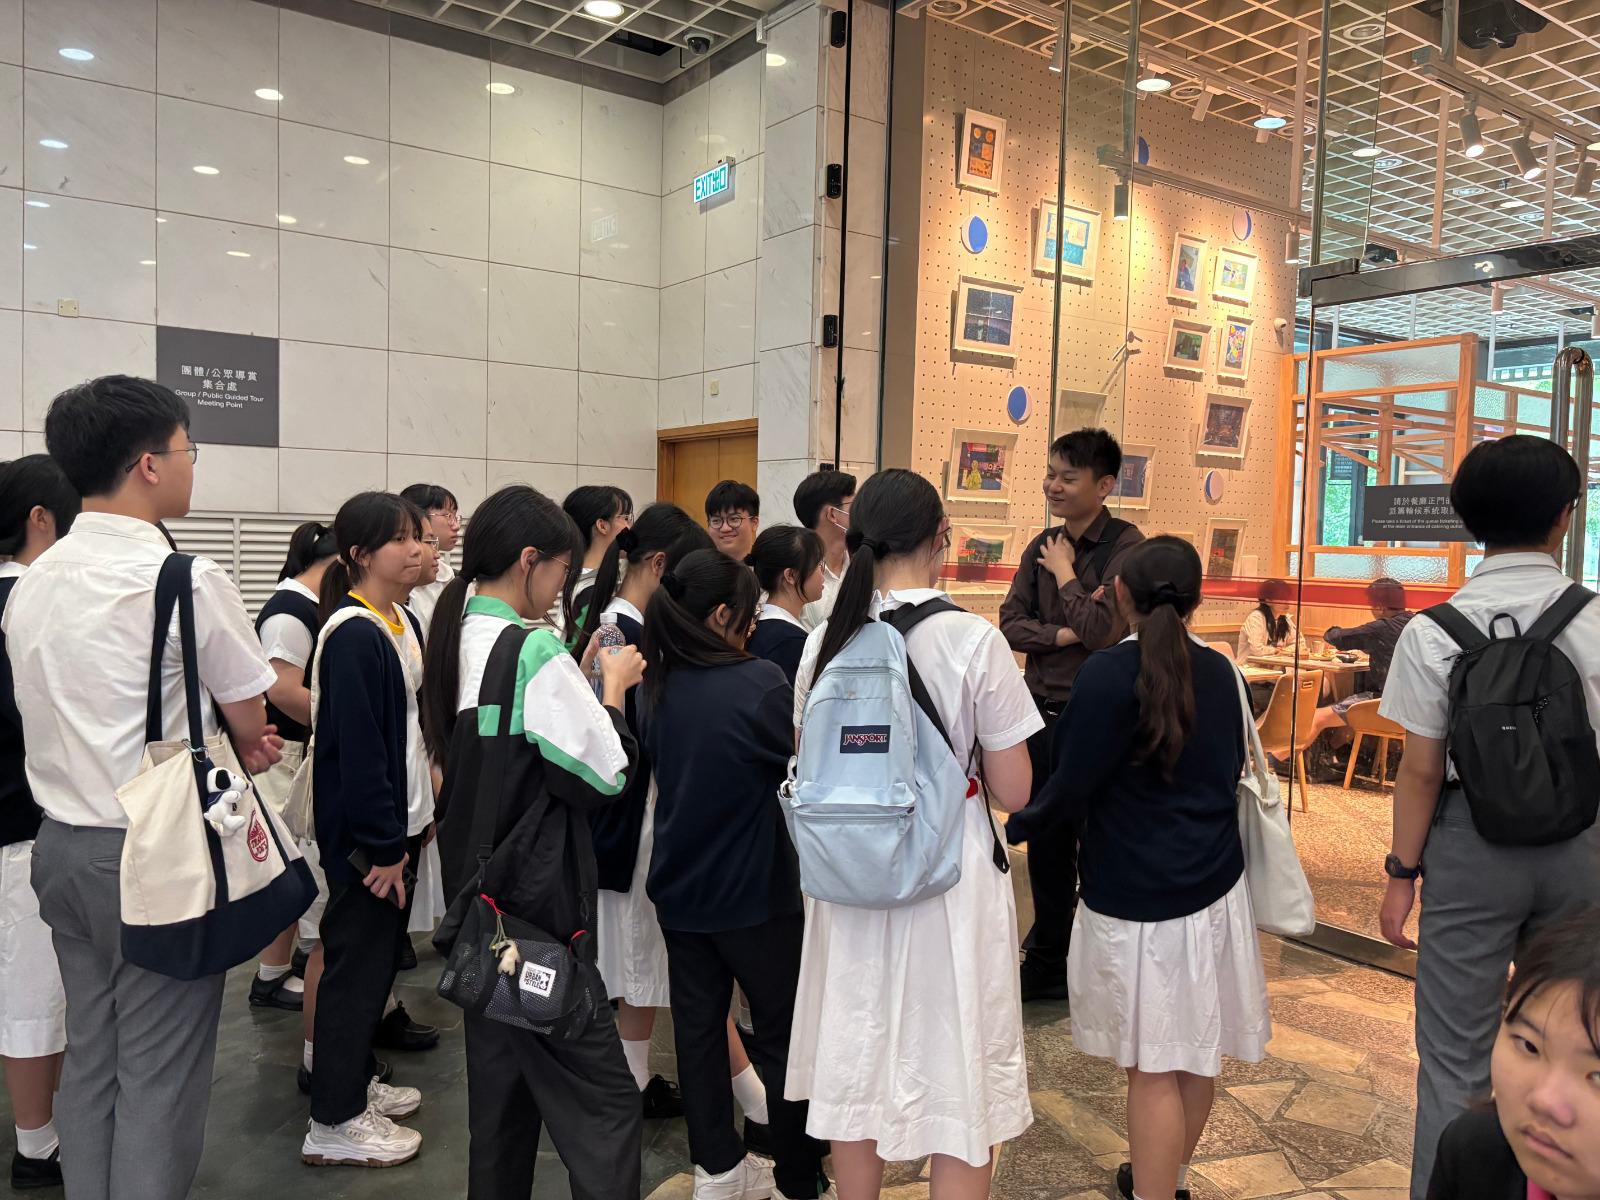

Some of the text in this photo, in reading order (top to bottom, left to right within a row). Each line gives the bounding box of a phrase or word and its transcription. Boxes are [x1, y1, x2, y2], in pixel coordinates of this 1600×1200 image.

[712, 166, 726, 192] 出口
[695, 173, 712, 200] EXIT
[181, 365, 258, 381] 團體/公眾導賞
[202, 379, 238, 392] 集合處
[175, 389, 197, 398] Group
[202, 391, 223, 399] Public
[224, 393, 249, 401] Guided
[197, 399, 243, 409] Meeting Point
[843, 733, 888, 746] JANSPORT
